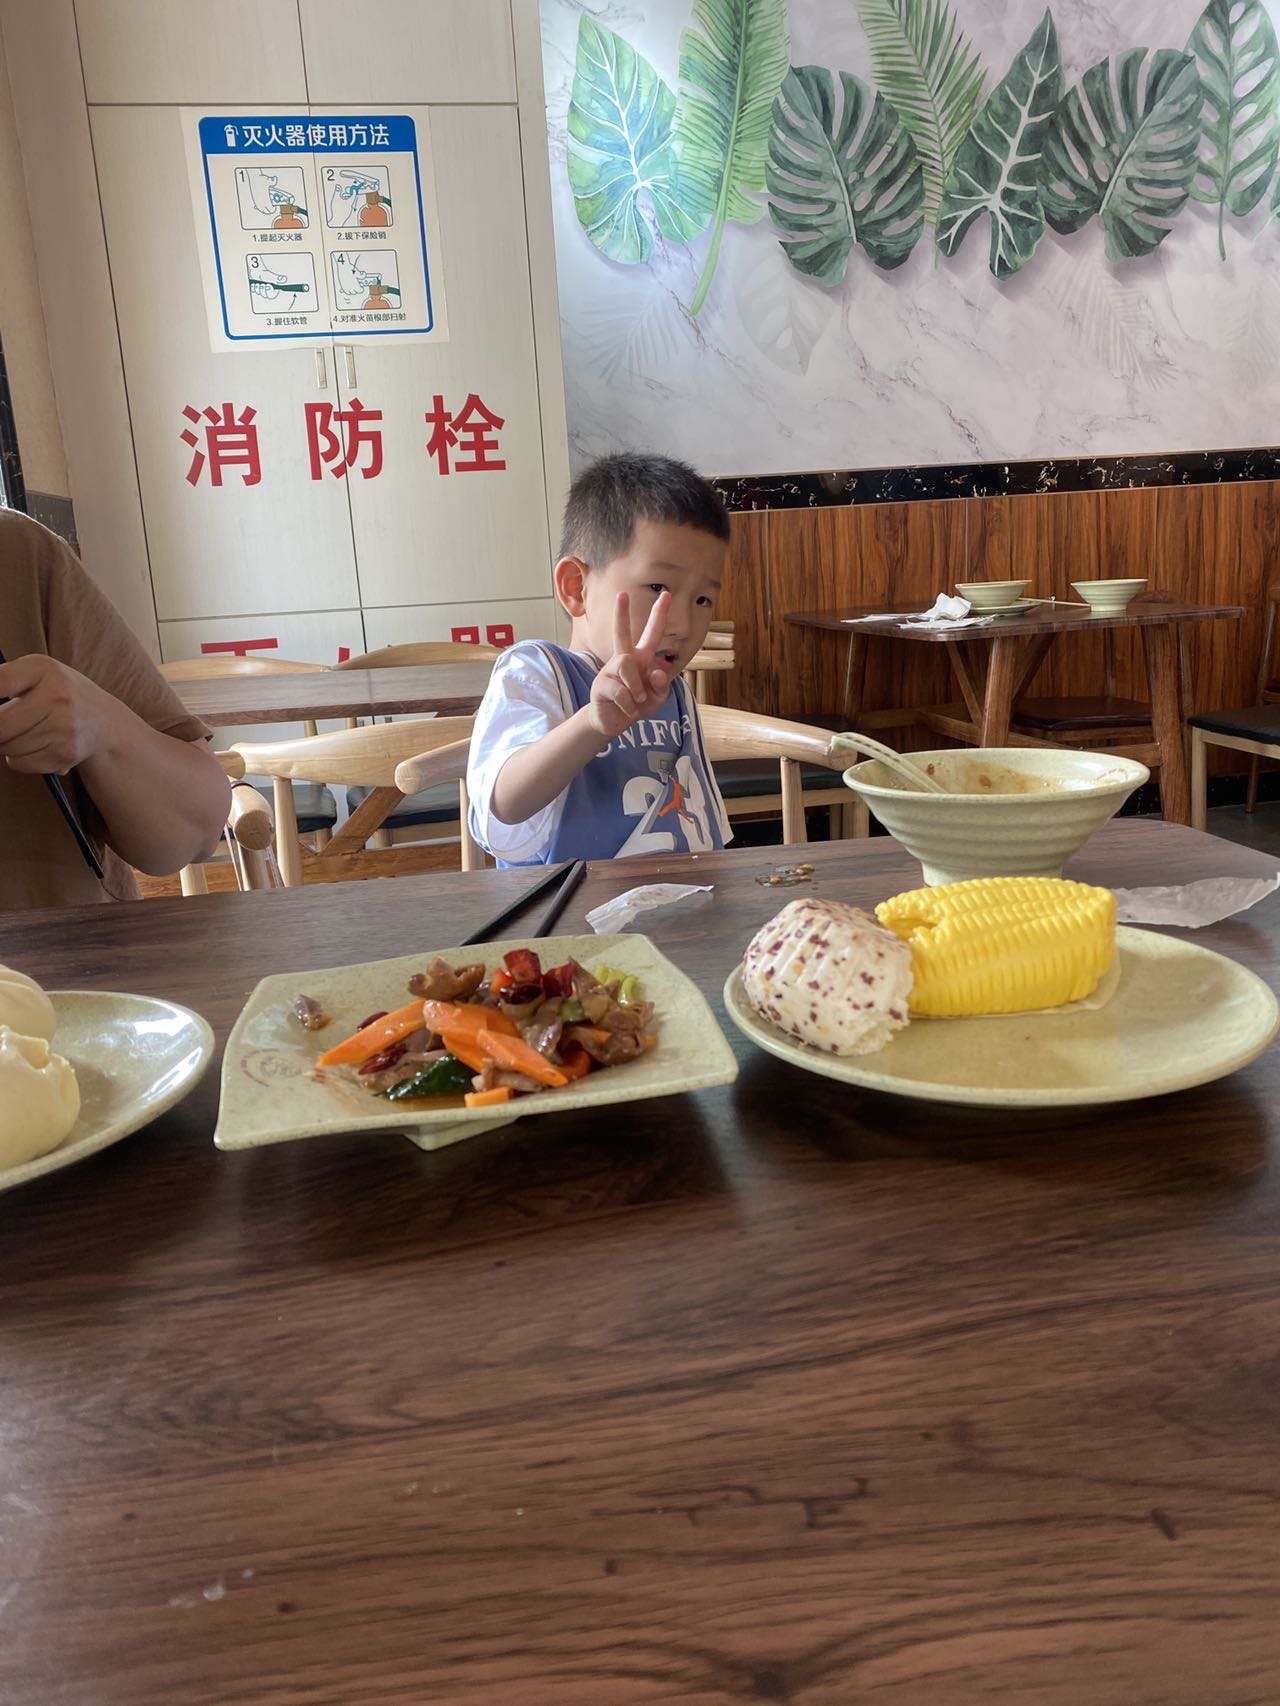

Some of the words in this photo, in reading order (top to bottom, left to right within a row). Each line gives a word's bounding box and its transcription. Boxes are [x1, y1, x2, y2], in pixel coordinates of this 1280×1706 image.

[242, 123, 390, 147] 灭火器使用方法
[239, 170, 245, 182] 1
[326, 169, 335, 181] 2
[250, 256, 259, 268] 3
[337, 253, 345, 265] 4
[180, 393, 507, 487] 消防栓
